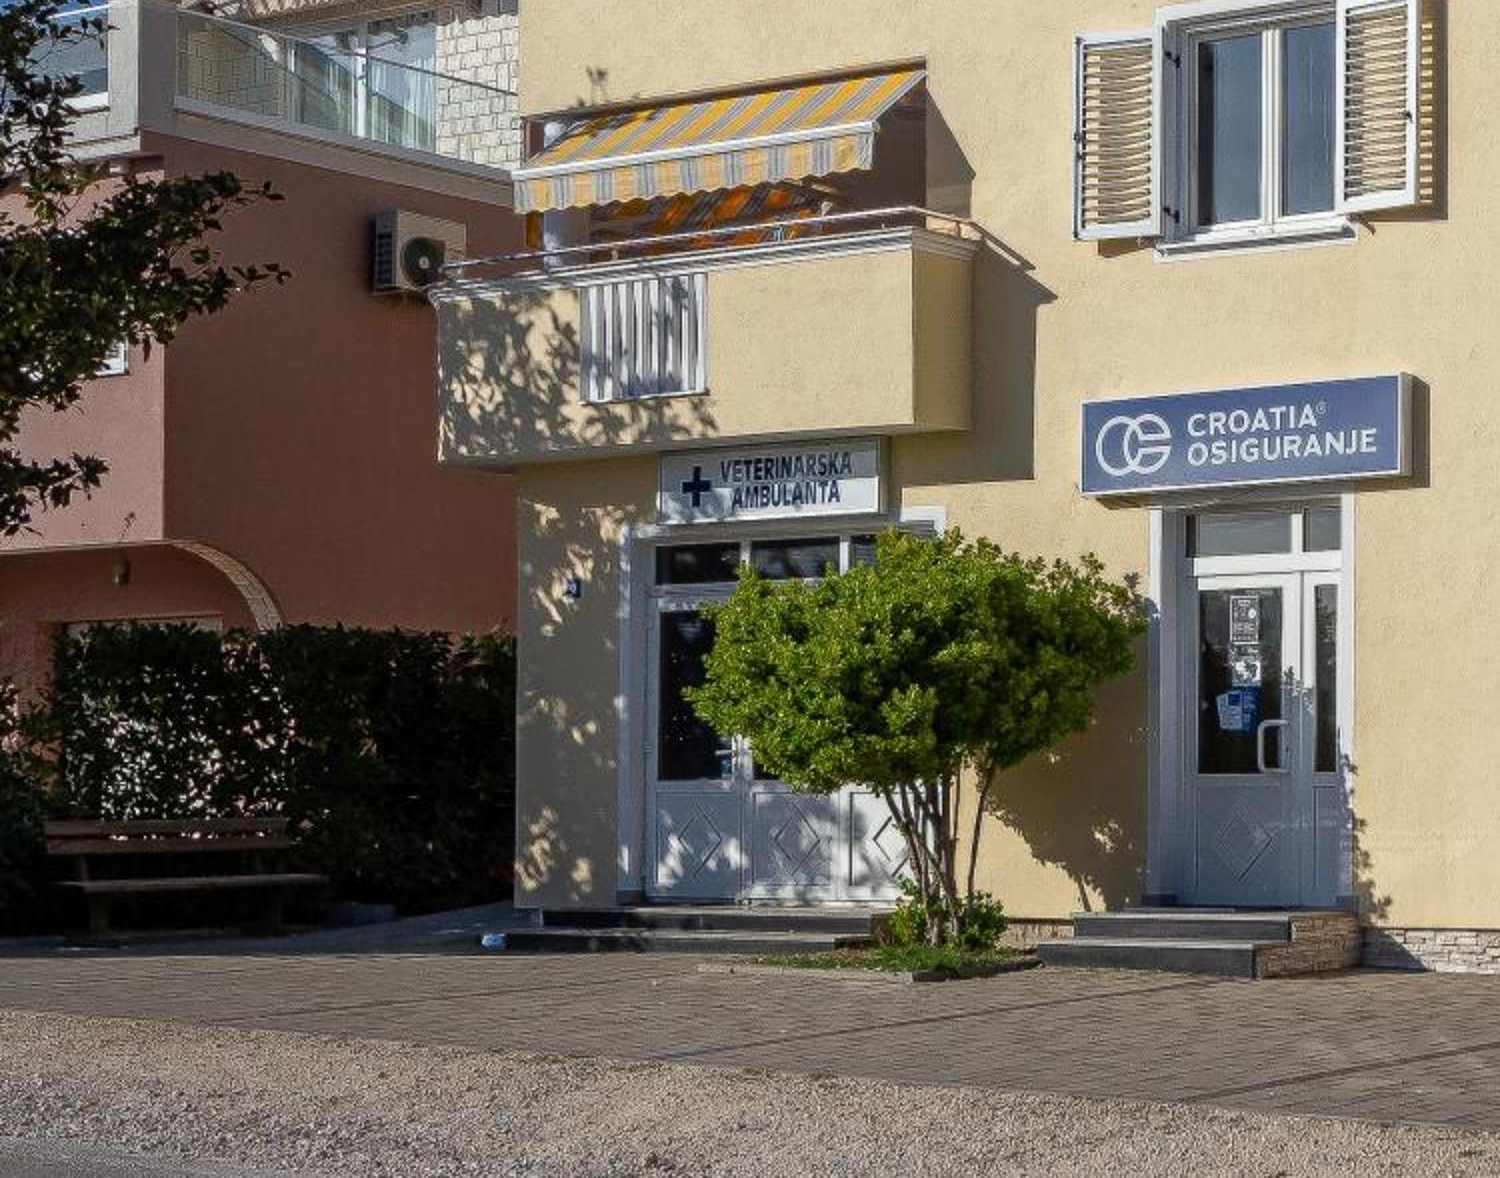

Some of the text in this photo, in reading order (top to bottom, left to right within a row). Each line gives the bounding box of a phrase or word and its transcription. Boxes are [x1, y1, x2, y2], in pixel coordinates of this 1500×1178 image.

[1187, 427, 1377, 466] OSIGURANJE
[720, 451, 851, 482] VETERINARSKA
[731, 480, 841, 510] AMBULANTA
